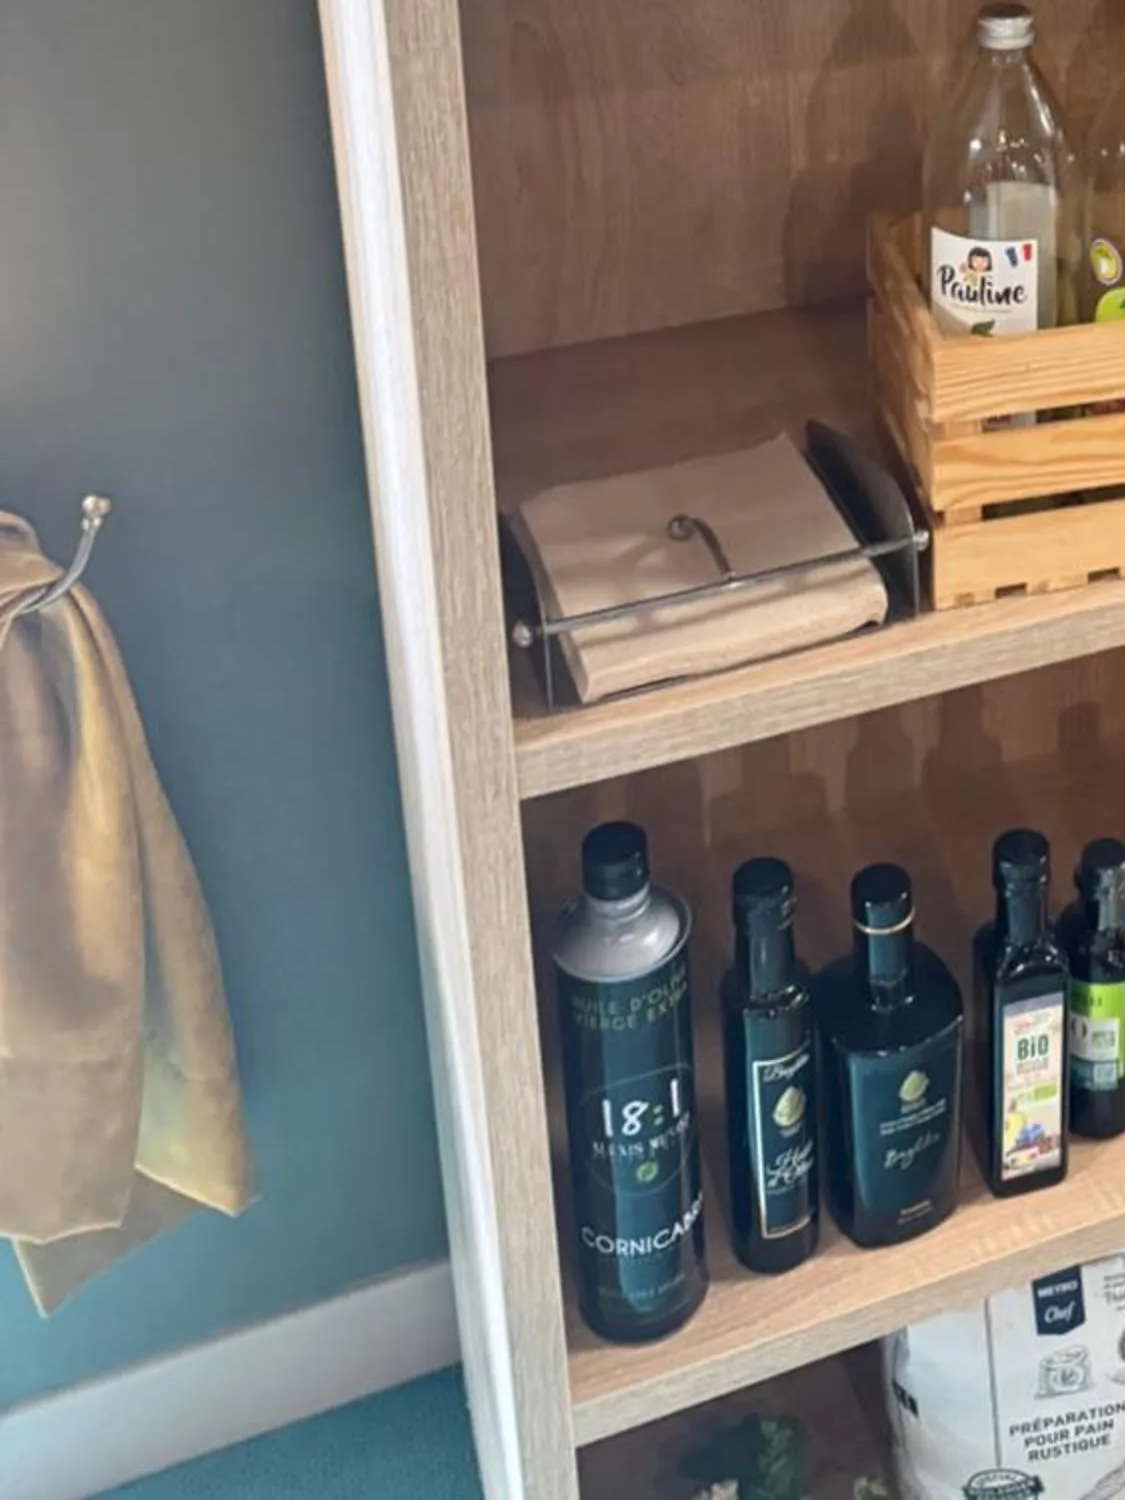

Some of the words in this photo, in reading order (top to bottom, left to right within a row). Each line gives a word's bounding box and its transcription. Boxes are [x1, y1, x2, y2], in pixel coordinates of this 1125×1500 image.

[937, 264, 1027, 307] Pauline
[602, 1077, 681, 1139] 18:1
[1044, 1299, 1076, 1324] Chef
[1024, 1428, 1070, 1448] POUR
[1074, 1418, 1115, 1438] PAIN
[1028, 1434, 1111, 1463] RUSTIQUE
